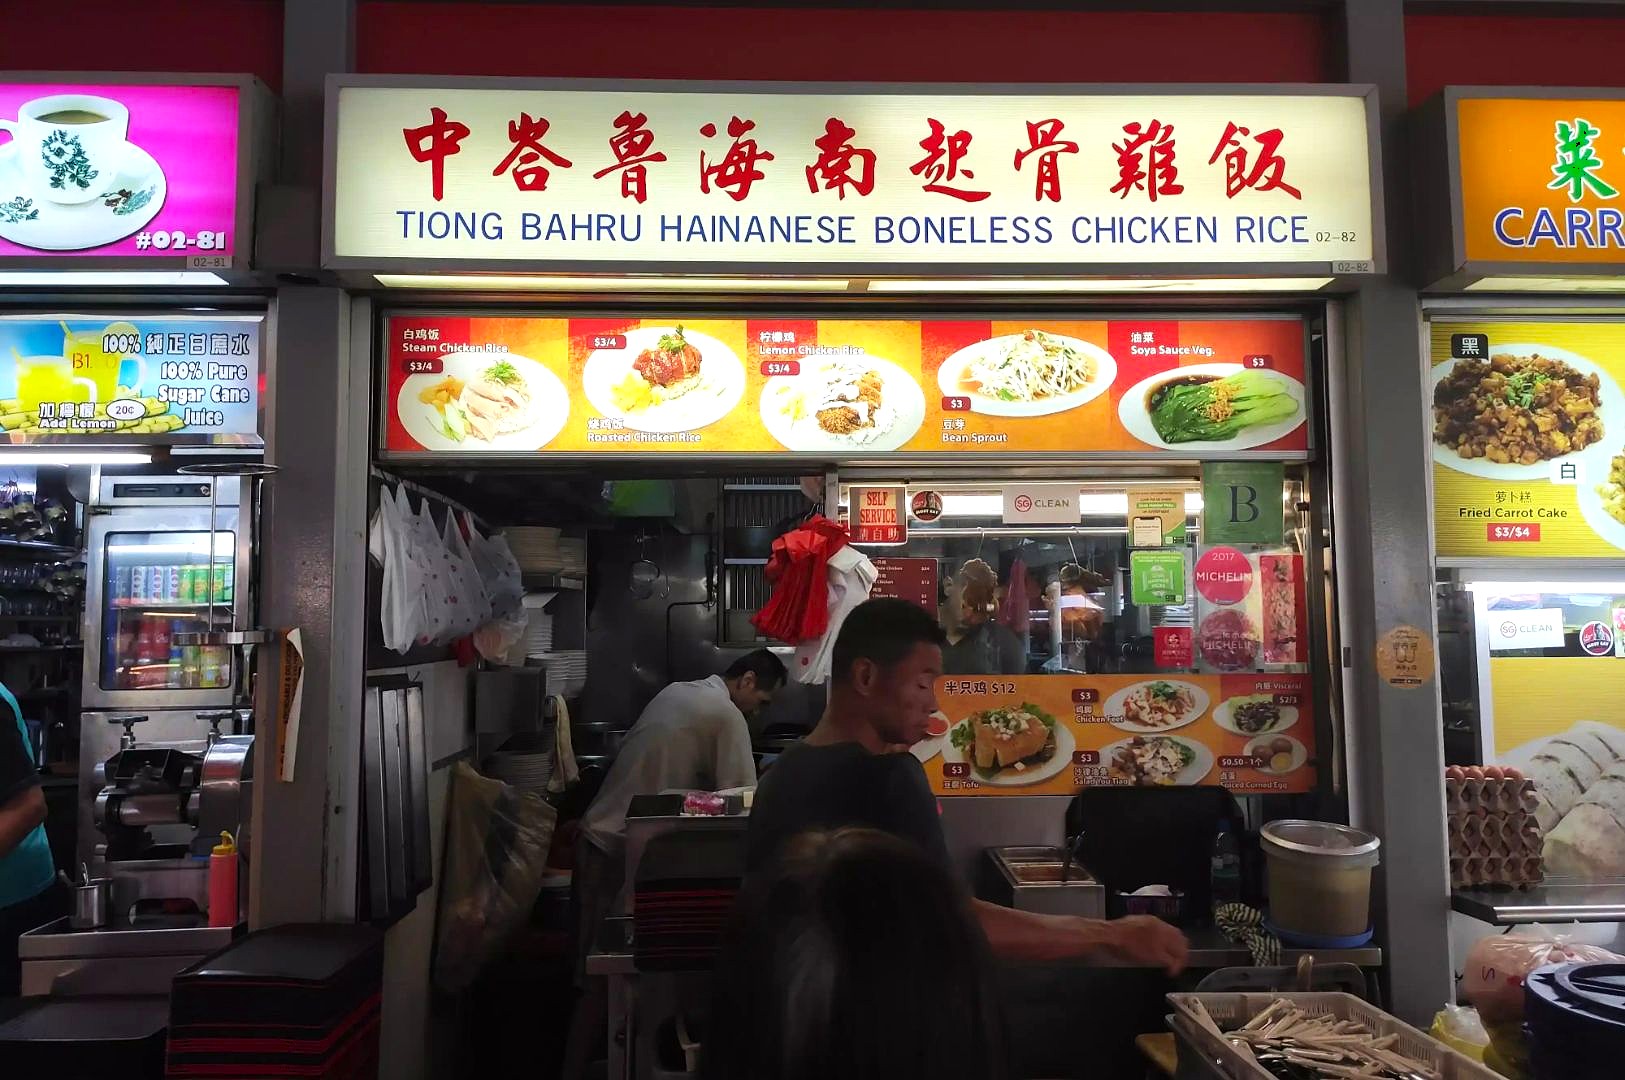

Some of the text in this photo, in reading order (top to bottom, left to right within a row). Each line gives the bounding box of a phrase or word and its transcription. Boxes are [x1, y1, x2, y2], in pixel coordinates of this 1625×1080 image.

[1546, 118, 1625, 203] 菜
[396, 210, 1310, 244] TIONG BAHRU HAINANESE BONELESS CHICKEN RICE
[135, 230, 226, 250] #02-81
[1315, 230, 1357, 243] 02-82
[193, 257, 226, 267] 02-81
[1337, 262, 1369, 273] 02-82
[403, 328, 440, 341] 白鸡饭
[1130, 331, 1154, 344] 油菜
[102, 333, 141, 354] 100%
[593, 336, 617, 347] $3/4
[1460, 337, 1480, 355] 黑
[402, 342, 509, 354] Steam Chicken Rice
[759, 345, 865, 356] Lemon Chicken Rice
[1130, 345, 1215, 357] Soya Sauce Veg.
[409, 360, 433, 372] $3/4
[1252, 356, 1265, 368] $3
[160, 361, 248, 380] 100% Pure
[768, 363, 791, 374] $3/4
[157, 384, 250, 406] Sugar Cane
[950, 399, 963, 410] $3
[183, 407, 224, 426] Juice
[39, 418, 117, 428] Add Lemon
[942, 418, 966, 431] 豆芽
[587, 432, 702, 443] Roasted Chicken Rice
[942, 432, 1008, 444] Bean Sprout
[1560, 461, 1577, 480] 白
[866, 491, 889, 506] SELF
[1495, 490, 1532, 504] 萝卜糕
[1016, 499, 1070, 508] SG CLEAN
[1229, 485, 1260, 523] B
[860, 508, 897, 523] SERVICE
[1459, 507, 1568, 518] Fried Carrot Cake
[1494, 526, 1531, 538] $3/$4
[1212, 552, 1235, 561] 2017
[1196, 572, 1252, 583] MICHELIN
[1519, 624, 1553, 634] CLEAN
[944, 681, 1016, 695] 半只鸡 $12
[1079, 691, 1091, 700] $3
[1075, 715, 1106, 723] Chicken
[1080, 753, 1092, 762] $3
[1221, 758, 1244, 766] $0.50
[951, 765, 963, 774] $3
[962, 780, 979, 789] Tofu
[1074, 777, 1095, 785] Salad
